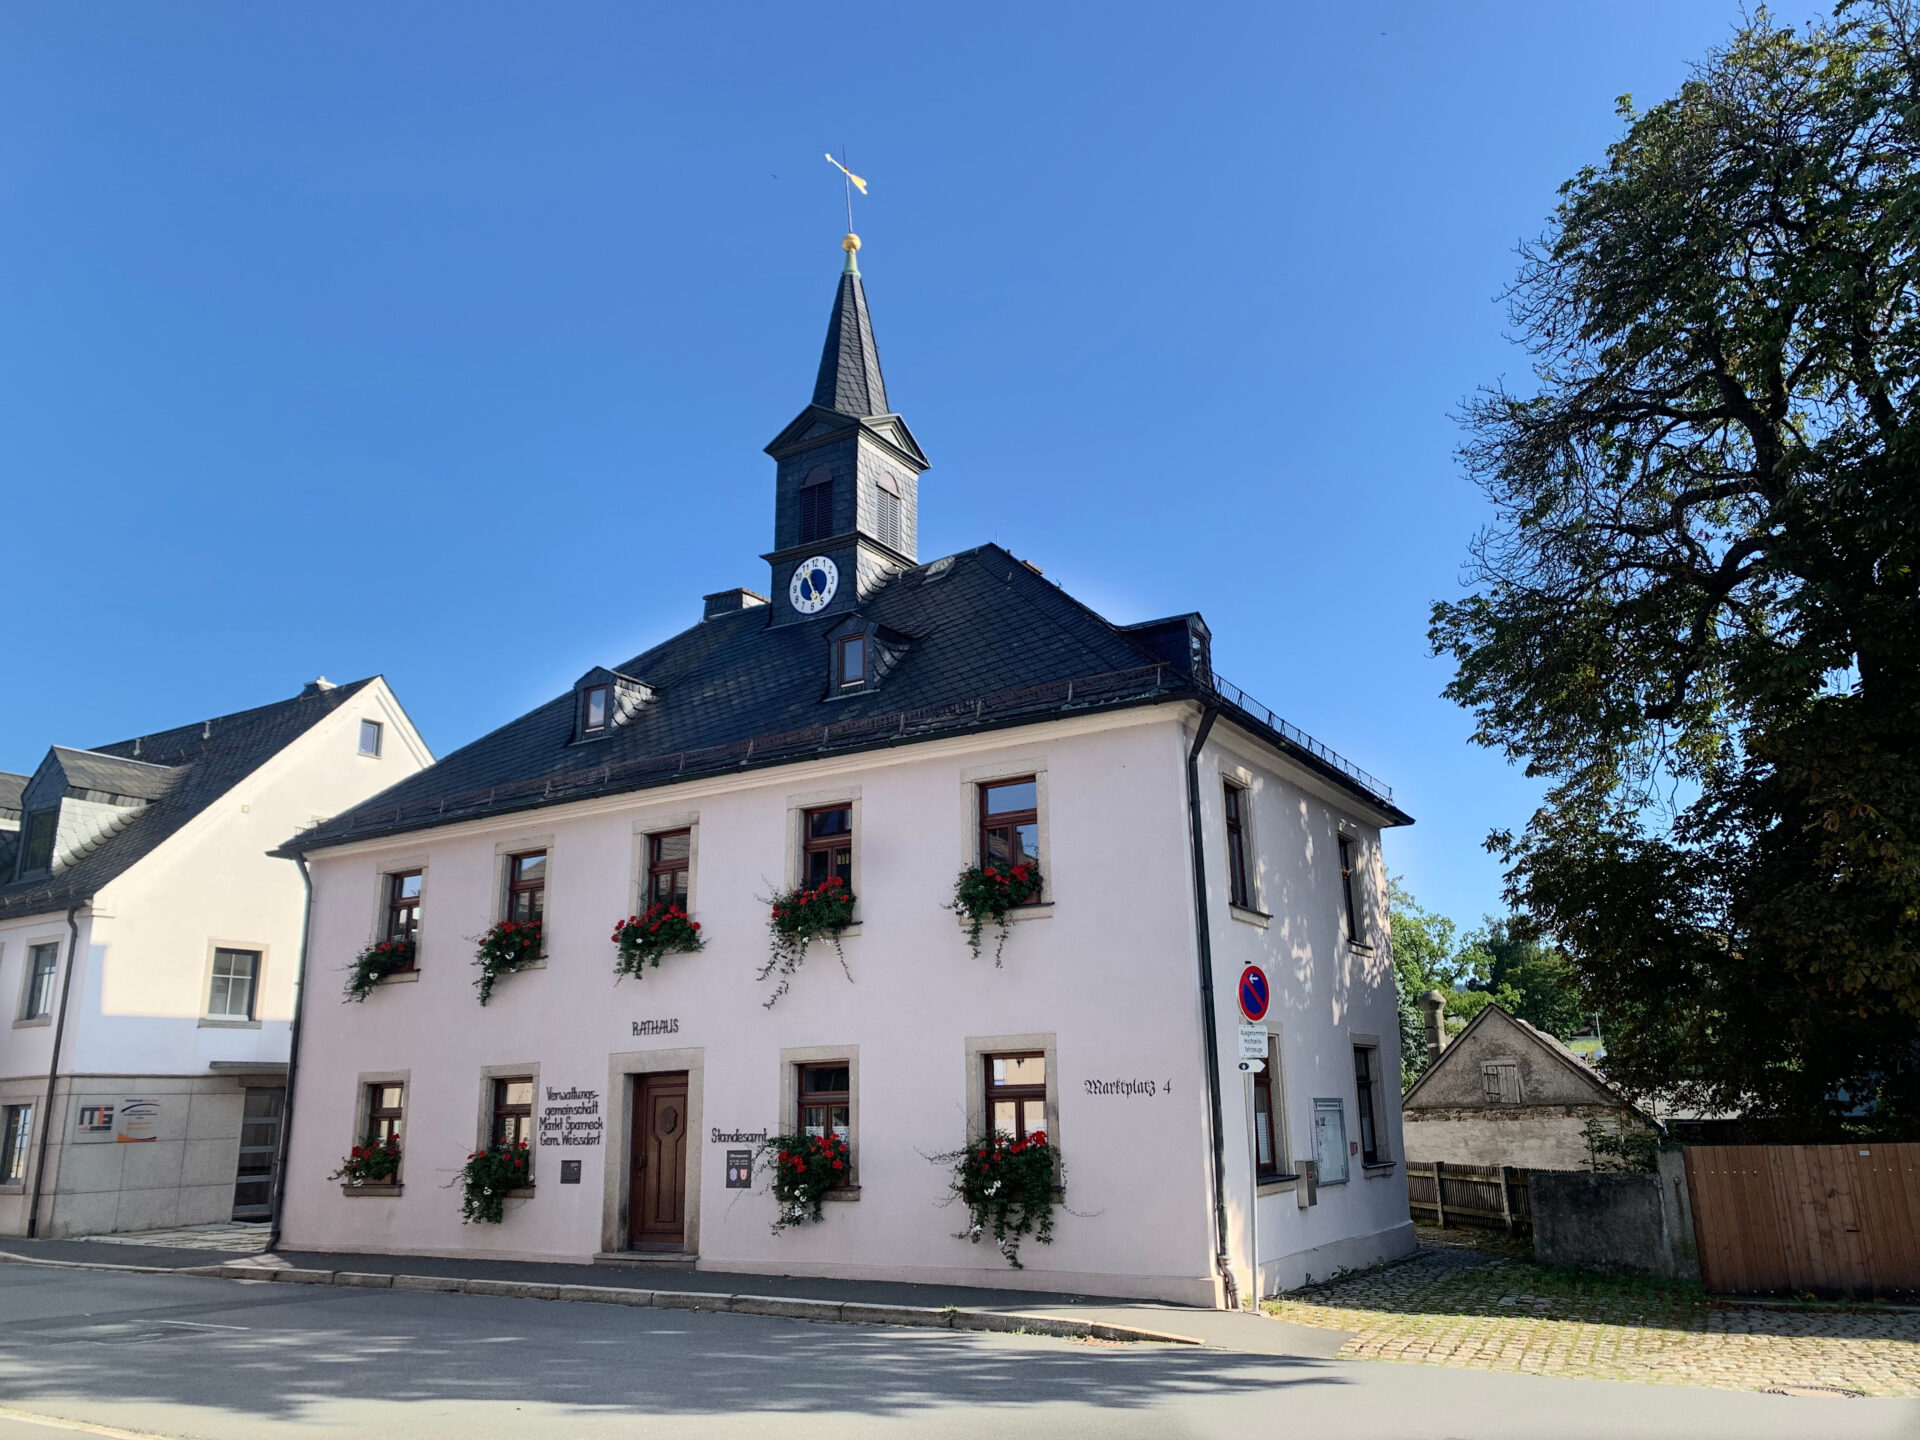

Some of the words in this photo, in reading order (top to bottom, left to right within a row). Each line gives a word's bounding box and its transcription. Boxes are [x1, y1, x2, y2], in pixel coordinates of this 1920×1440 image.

[802, 564, 809, 572] 11
[811, 558, 819, 568] 12
[828, 565, 833, 574] 2
[830, 576, 835, 584] 3
[792, 585, 798, 593] 9
[801, 601, 806, 610] 7
[819, 597, 824, 605] 5
[632, 1018, 679, 1036] RATHAUS
[546, 1086, 599, 1103] Verwaltungs-
[1083, 1078, 1156, 1099] Marktplatz
[1162, 1078, 1172, 1095] 4
[545, 1100, 598, 1120] gemeinschaft
[539, 1117, 563, 1130] Markt
[565, 1116, 603, 1134] Sparneck
[540, 1131, 560, 1146] Gem.
[561, 1131, 601, 1146] Weissdorf
[711, 1127, 768, 1144] Standesamt
